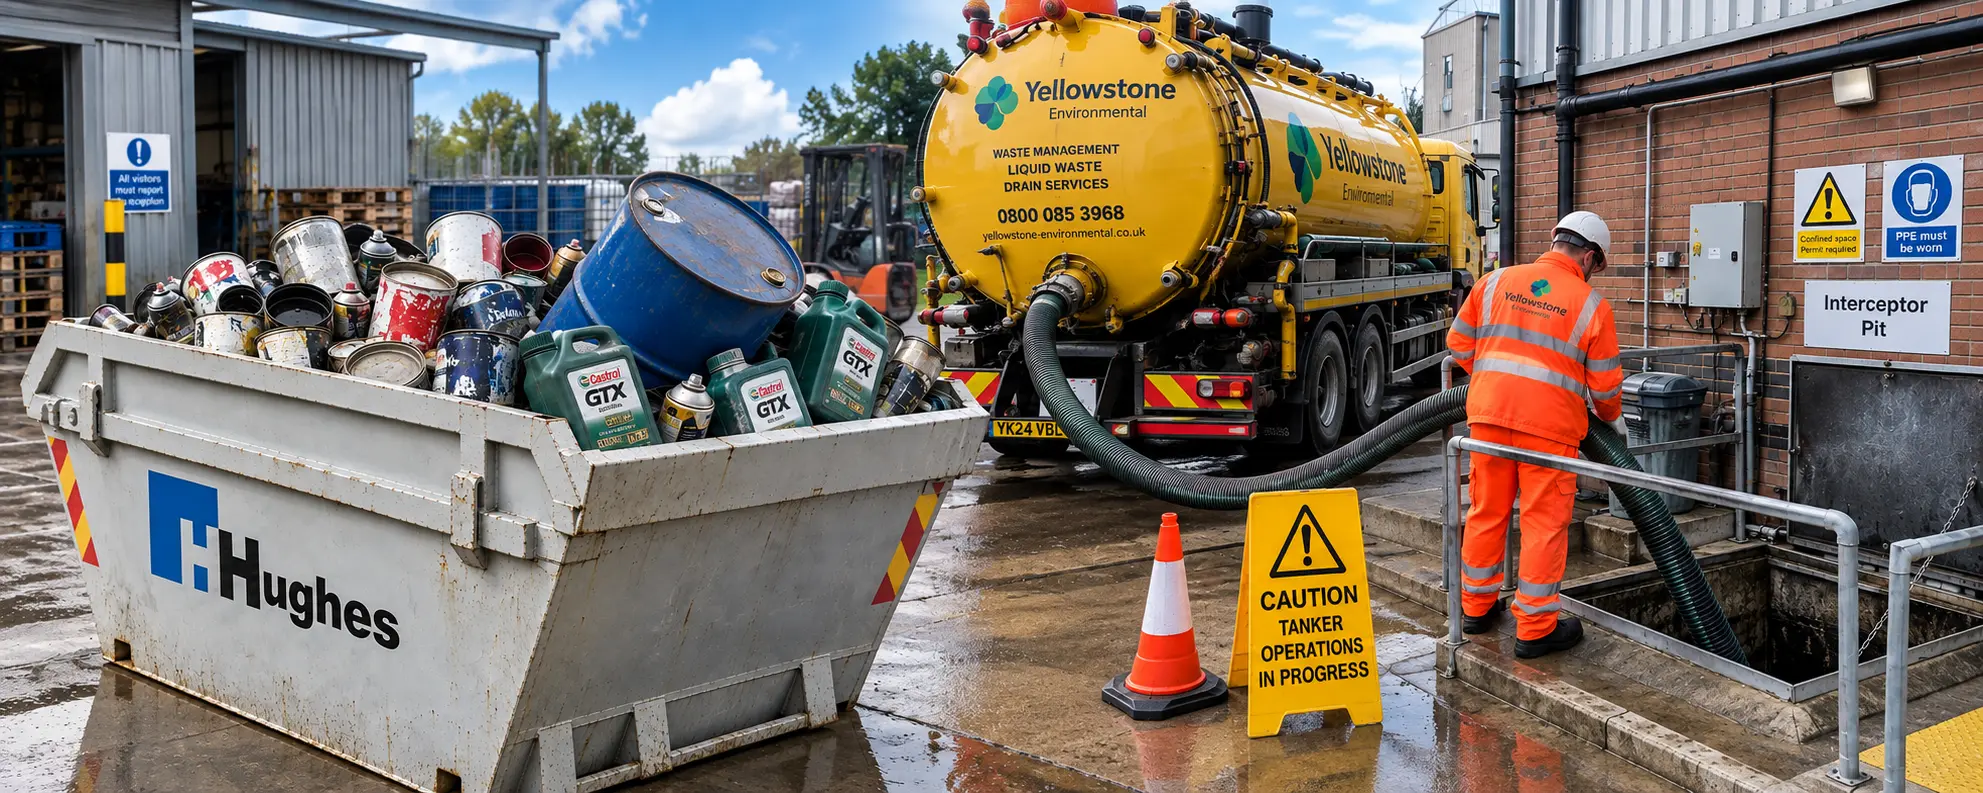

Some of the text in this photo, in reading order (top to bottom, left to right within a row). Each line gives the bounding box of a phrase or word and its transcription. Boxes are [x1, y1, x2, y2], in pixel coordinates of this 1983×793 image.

[1025, 78, 1176, 102] Yellowstone
[1049, 105, 1147, 120] Environmental
[993, 144, 1120, 159] WASTE MANAGEMENT
[1320, 133, 1407, 185] Yellowstone
[1008, 161, 1102, 176] LIQUID WASTE
[118, 174, 130, 183] All
[1004, 178, 1109, 192] DRAIN SERVICES
[997, 205, 1125, 224] 0800 085 3968
[982, 227, 1146, 243] yellowstone-environmental.co.uk
[1800, 235, 1833, 244] Confined
[1896, 230, 1947, 241] PPE must
[1900, 243, 1943, 253] be worn
[1505, 291, 1568, 317] Yellowstone
[1824, 294, 1929, 316] Interceptor
[1861, 320, 1887, 337] Pit
[843, 350, 873, 378] GTX
[589, 367, 621, 385] Castrol
[585, 381, 627, 407] GTX
[756, 393, 791, 419] GTX
[997, 422, 1063, 436] YK24 VBL
[218, 528, 401, 650] Hughes
[1260, 585, 1358, 611] CAUTION
[1279, 615, 1344, 636] TANKER
[1261, 637, 1364, 662] OPERATIONS
[1259, 661, 1369, 688] IN PROGRESS
